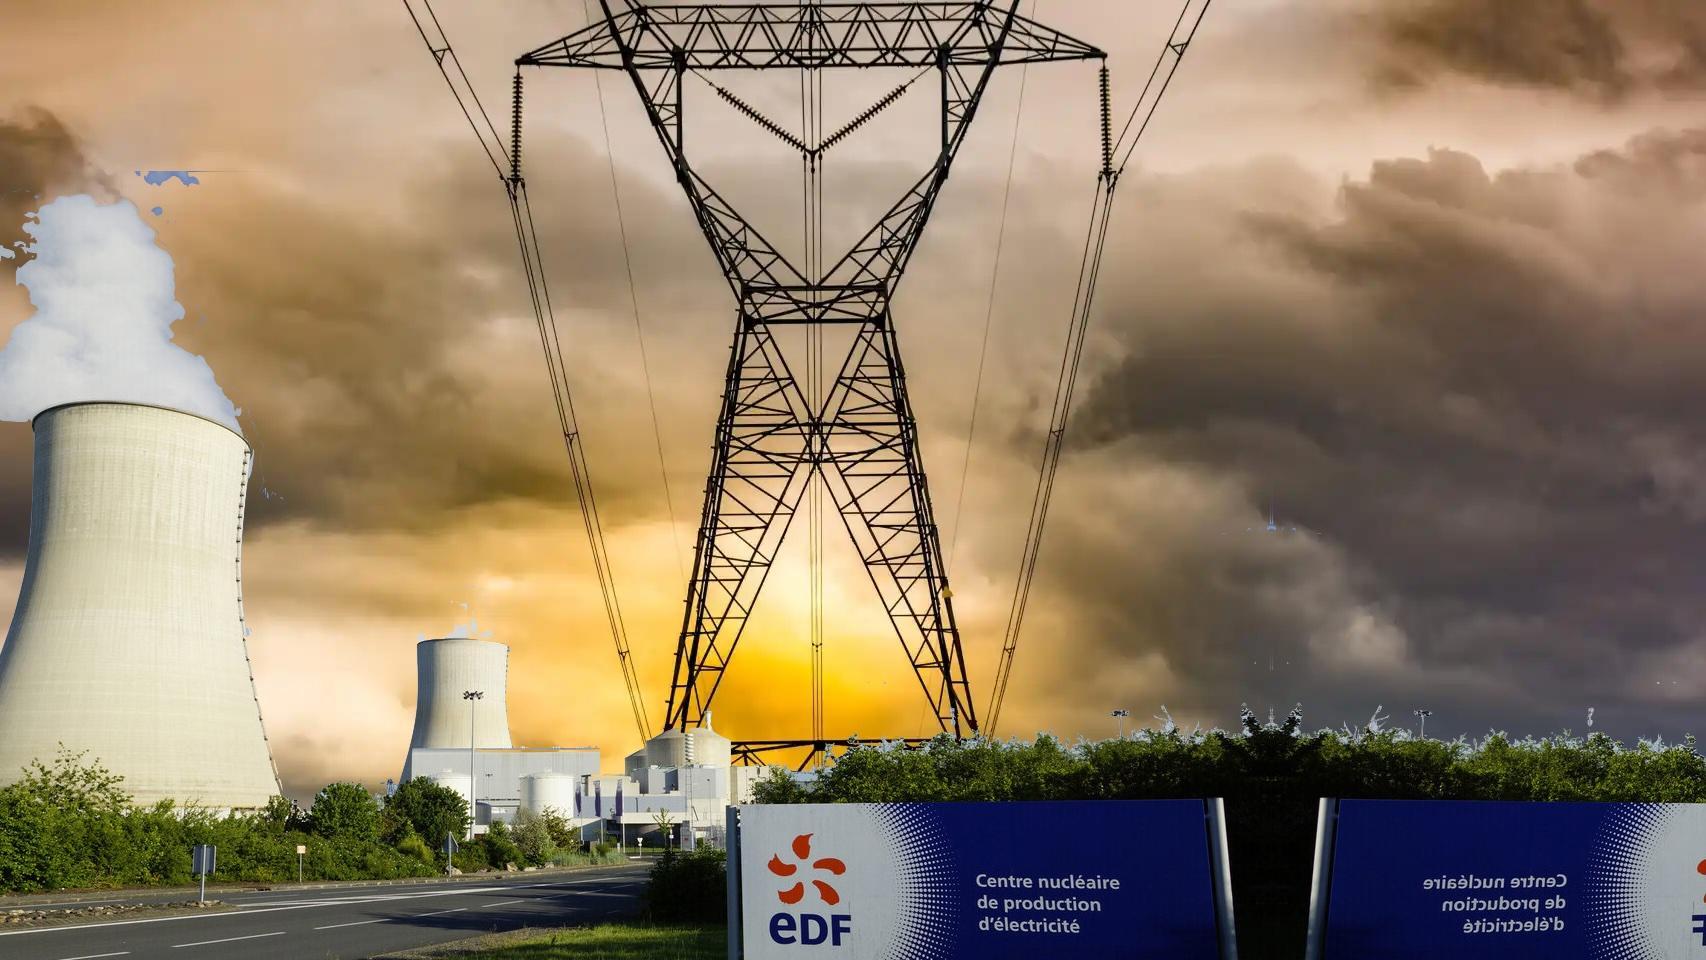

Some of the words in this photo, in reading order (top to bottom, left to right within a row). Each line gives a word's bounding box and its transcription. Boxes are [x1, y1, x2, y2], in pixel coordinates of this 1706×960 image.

[976, 873, 1033, 889] Centre
[1038, 873, 1120, 890] nucléaire
[977, 894, 999, 910] de
[1003, 894, 1101, 913] production
